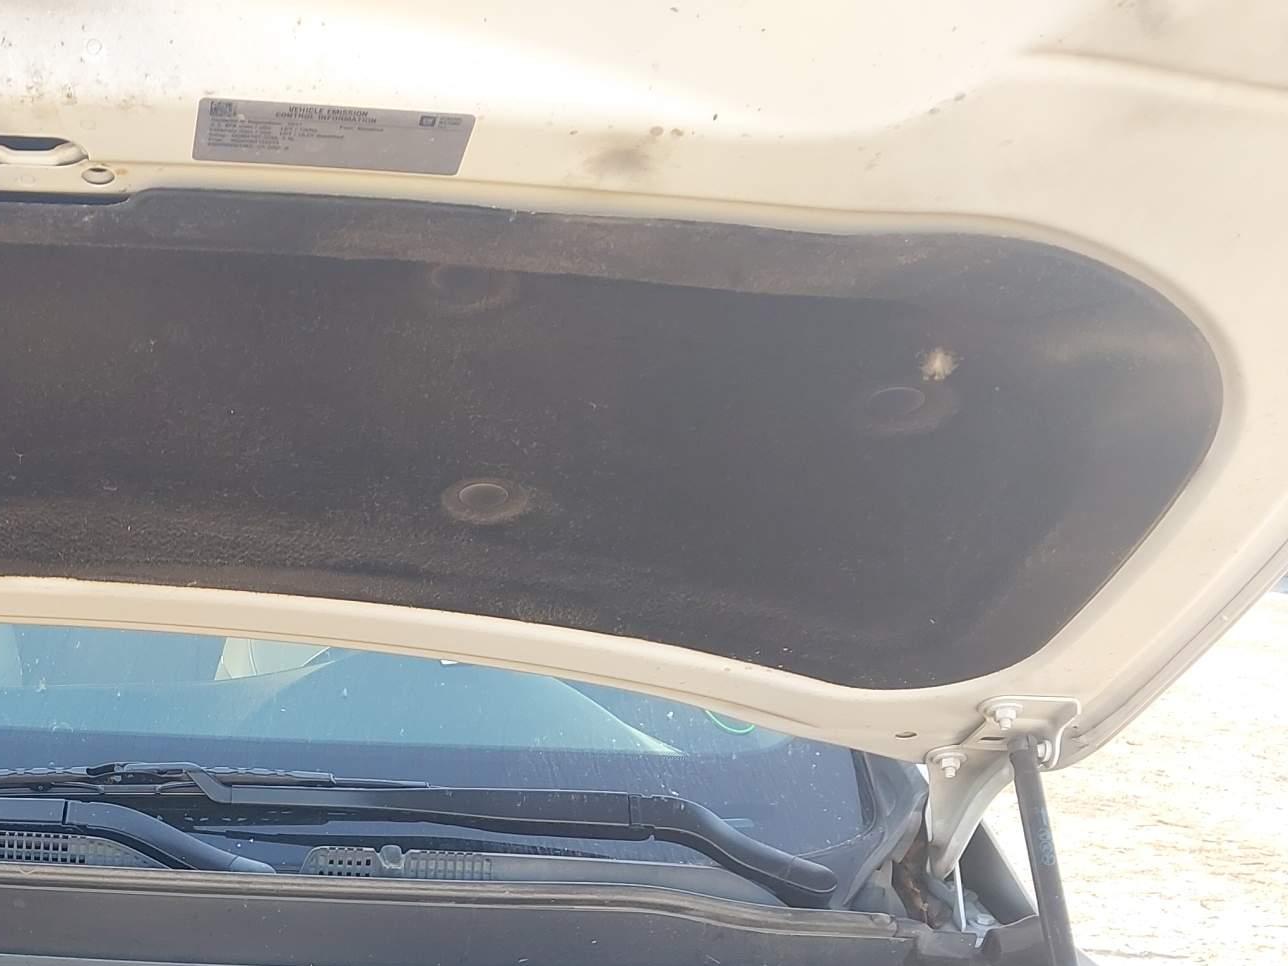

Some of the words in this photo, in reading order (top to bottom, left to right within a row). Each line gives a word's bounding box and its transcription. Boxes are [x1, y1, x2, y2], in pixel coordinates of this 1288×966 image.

[288, 105, 324, 114] VEHICLE
[326, 108, 369, 117] EMISSION
[275, 111, 314, 120] CONTROL
[318, 114, 377, 124] INFORMATION
